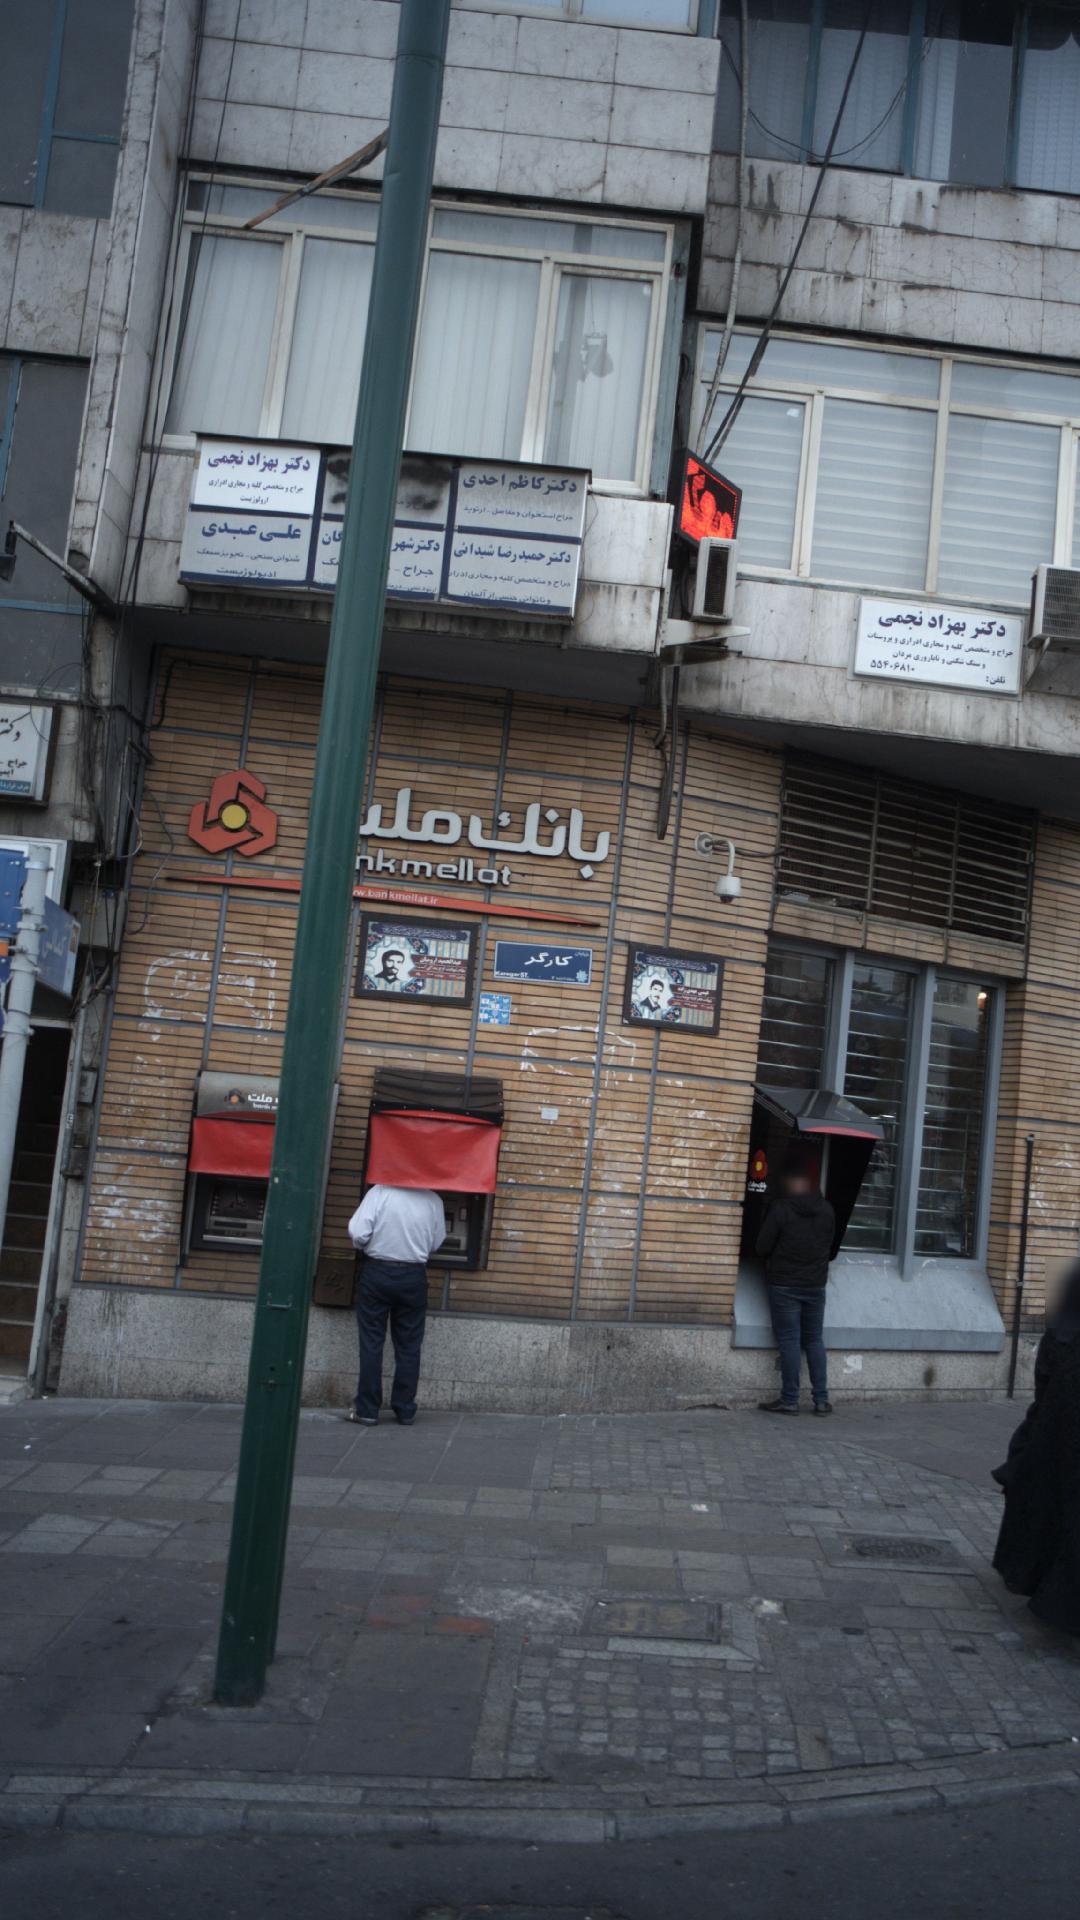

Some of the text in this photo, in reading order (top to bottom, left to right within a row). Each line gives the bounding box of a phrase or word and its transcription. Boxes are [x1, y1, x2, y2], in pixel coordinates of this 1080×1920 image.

[207, 450, 310, 474] دکتر بهزاد نجمی
[463, 473, 577, 496] دکتر کاظم احدی
[201, 521, 302, 542] علی عبدی
[392, 537, 440, 554] دکتر شهر
[546, 550, 571, 566] دکتر
[402, 565, 434, 577] جراح
[878, 610, 1006, 639] دکتر بهزاد نجمی
[899, 635, 922, 647] ادراری
[923, 639, 944, 649] مجاری
[891, 649, 912, 661] مردان
[964, 645, 990, 654] متخصص
[997, 648, 1014, 659] جراح
[468, 802, 611, 881] بانک
[355, 848, 512, 887] nk mellat
[353, 889, 438, 905] w.bankmellat.ir
[524, 952, 573, 968] کارگر
